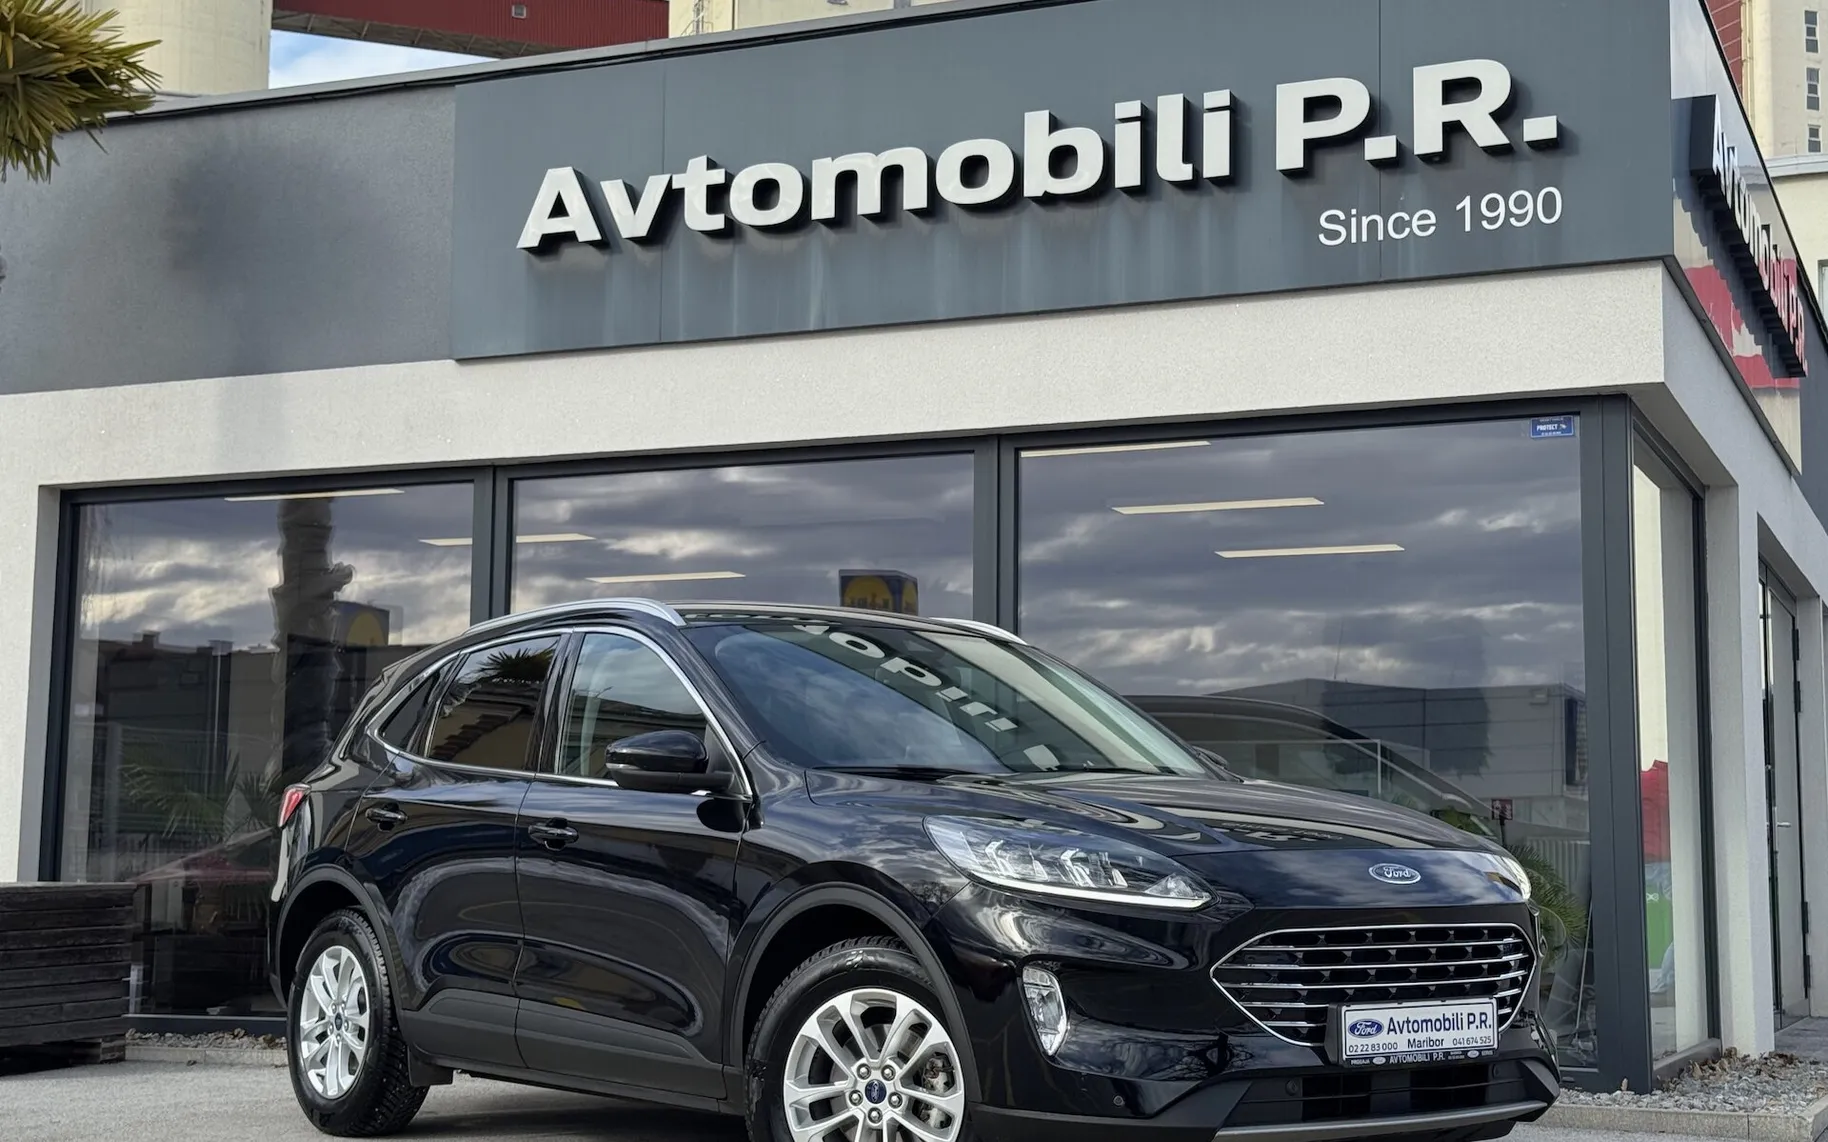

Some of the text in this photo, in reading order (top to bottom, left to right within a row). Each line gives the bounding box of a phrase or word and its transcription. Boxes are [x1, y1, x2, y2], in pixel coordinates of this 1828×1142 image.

[517, 58, 1559, 252] Avtomobili P.R.
[1318, 186, 1563, 246] Since 1990
[1353, 1021, 1379, 1036] Ford
[1386, 1012, 1492, 1035] Avtomobili P.R.
[1407, 1036, 1444, 1049] Maribor
[1389, 1052, 1431, 1065] AVTOMOBILI
[1432, 1051, 1446, 1061] P.R.
